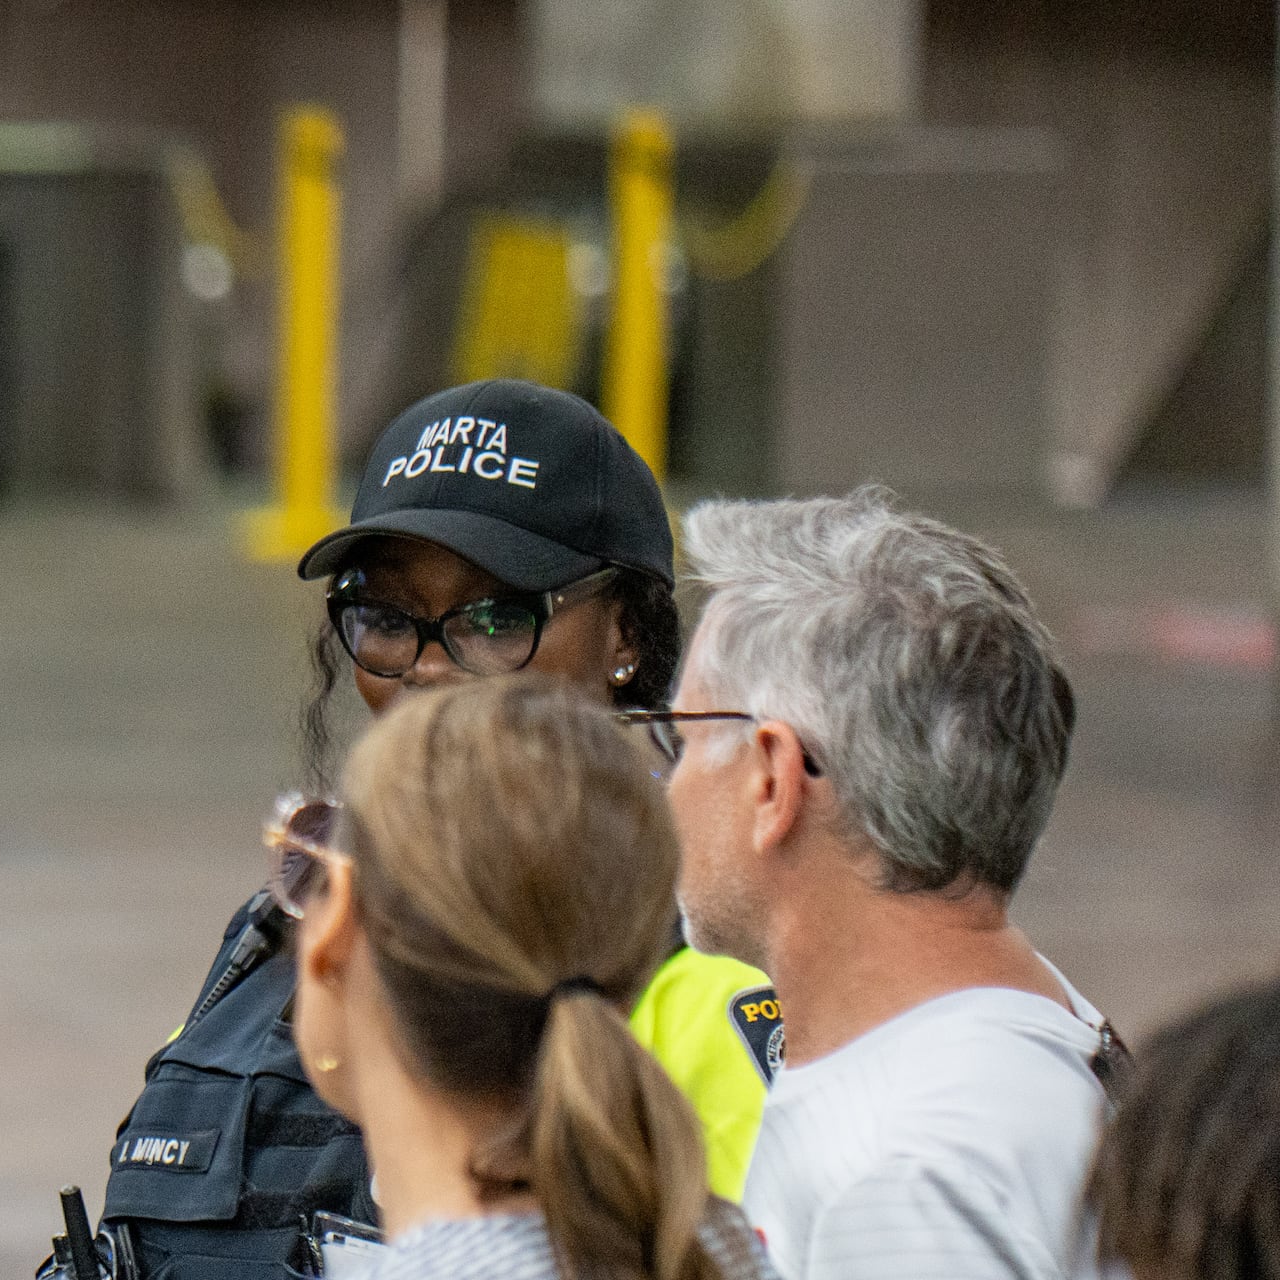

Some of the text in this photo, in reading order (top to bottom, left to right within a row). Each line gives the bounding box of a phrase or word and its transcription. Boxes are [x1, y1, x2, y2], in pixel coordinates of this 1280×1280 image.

[416, 416, 507, 454] MARTA
[382, 445, 540, 489] POLICE
[130, 1138, 190, 1165] MINCY
